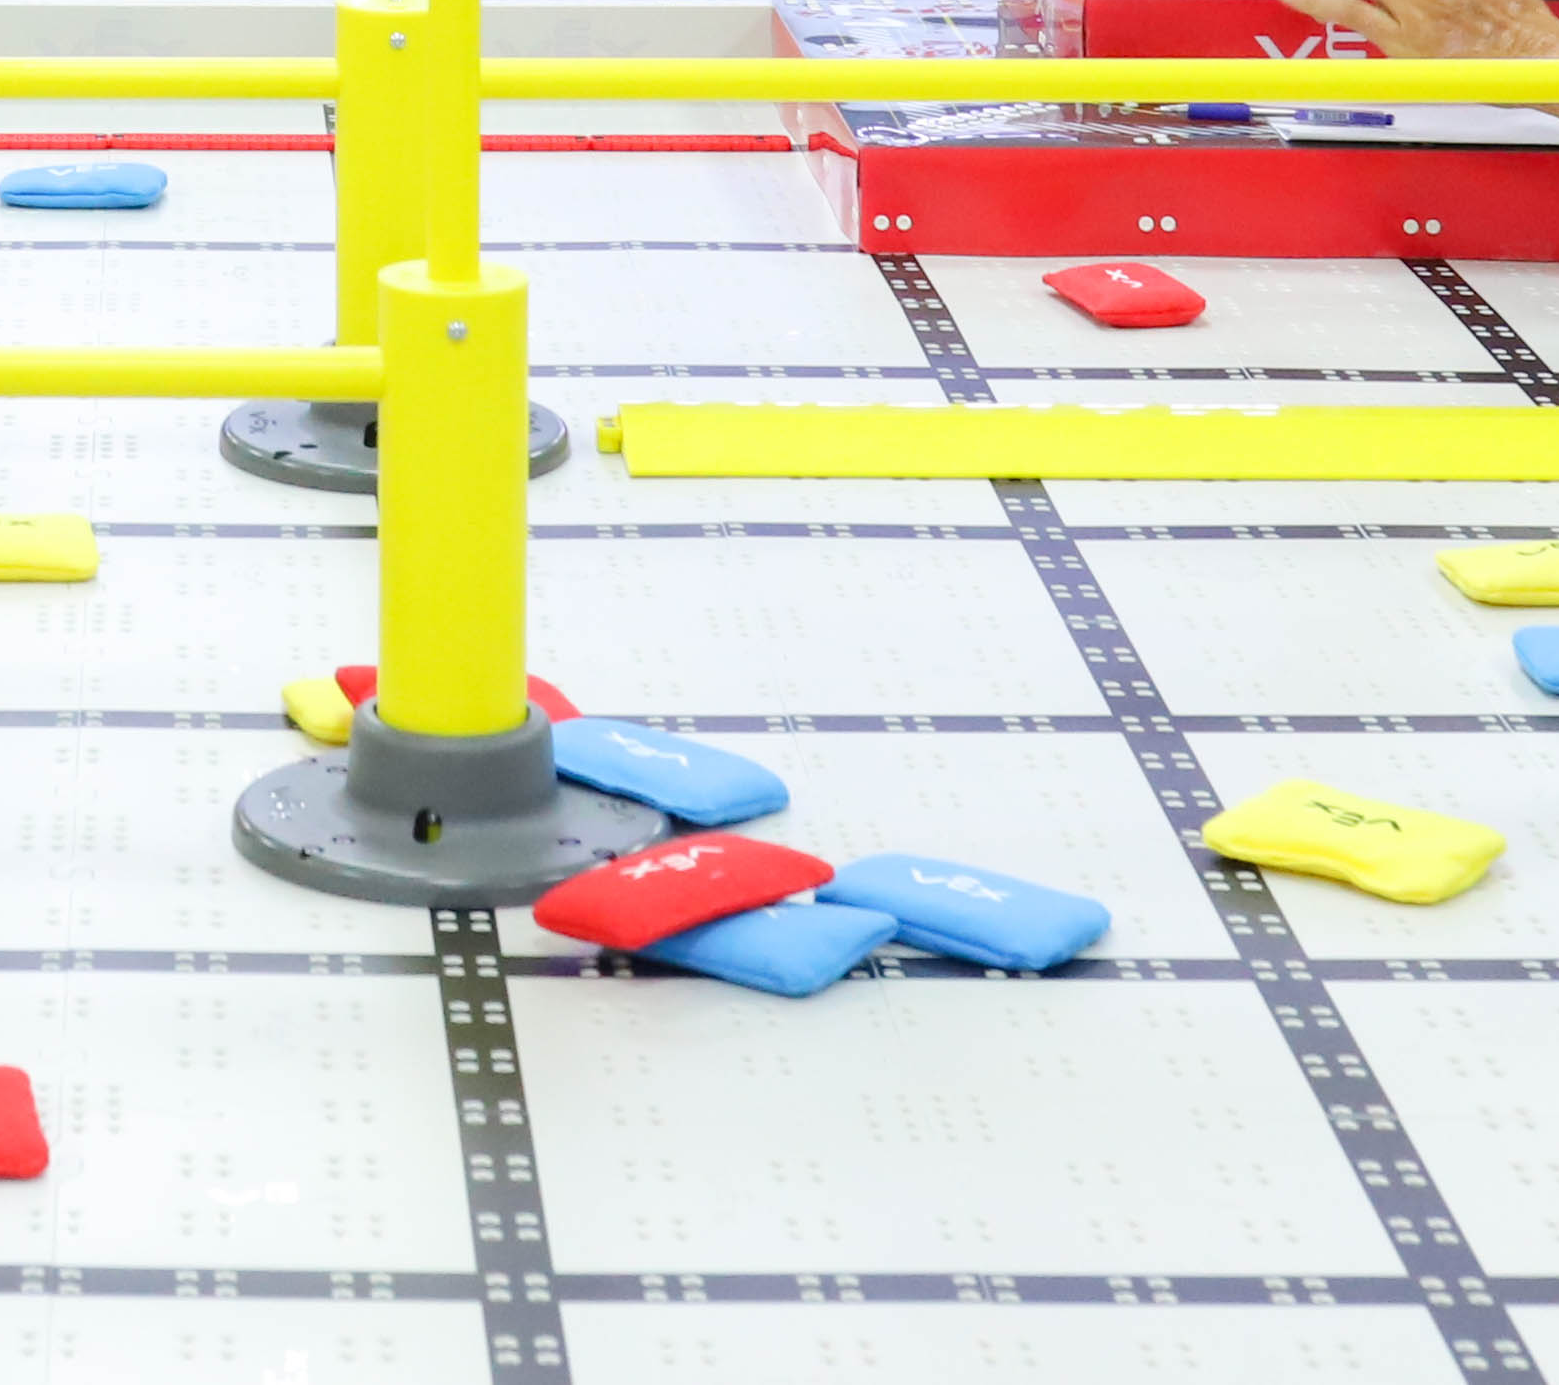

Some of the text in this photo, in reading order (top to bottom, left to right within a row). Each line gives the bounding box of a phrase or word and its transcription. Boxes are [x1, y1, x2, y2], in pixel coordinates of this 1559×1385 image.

[1254, 21, 1367, 59] VE
[1304, 799, 1403, 833] VEX
[619, 844, 729, 880] VEX
[910, 866, 1011, 904] VEX
